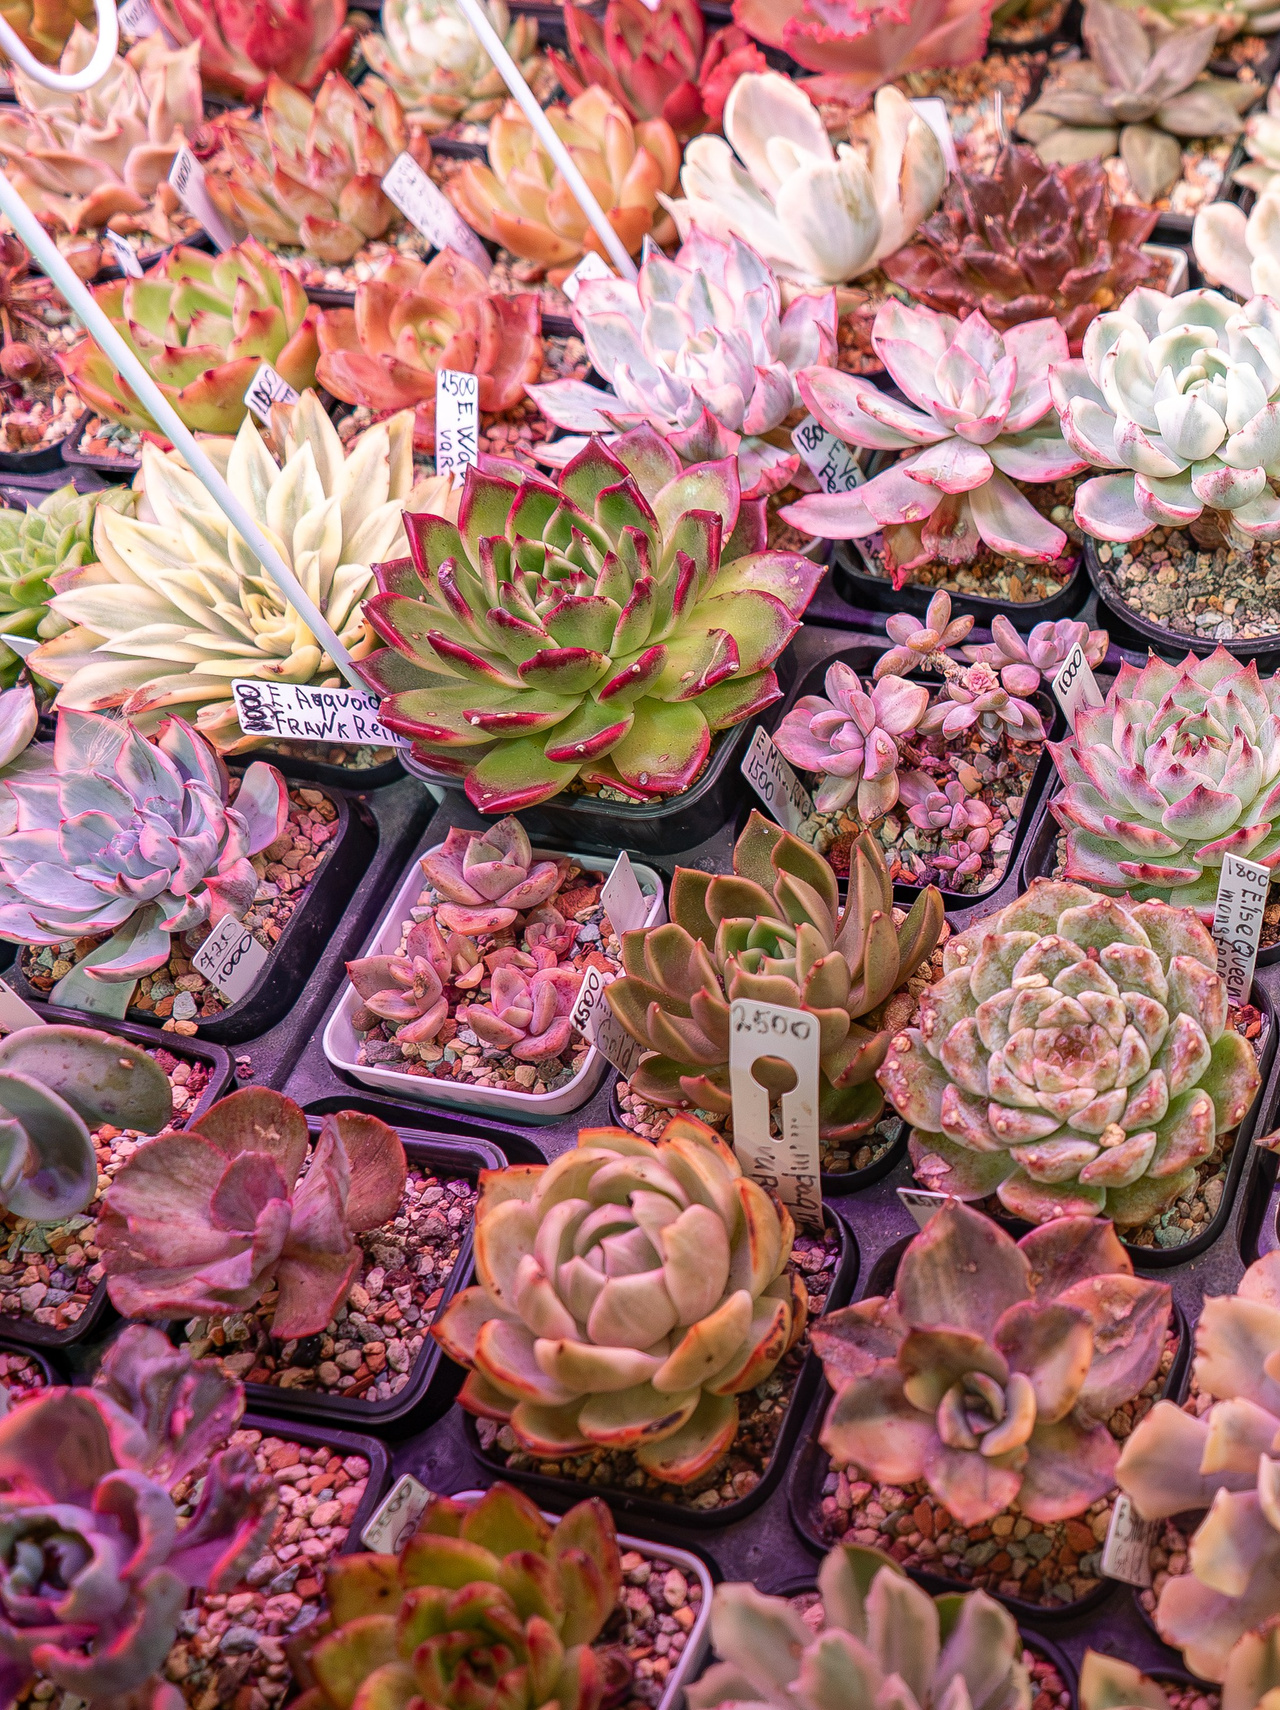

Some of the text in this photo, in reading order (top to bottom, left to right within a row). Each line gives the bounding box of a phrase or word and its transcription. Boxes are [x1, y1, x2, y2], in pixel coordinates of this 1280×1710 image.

[1058, 649, 1081, 695] 1000
[748, 755, 774, 801] 1500
[1229, 859, 1269, 887] 1800
[218, 934, 252, 985] 1000
[731, 1004, 811, 1040] 2500
